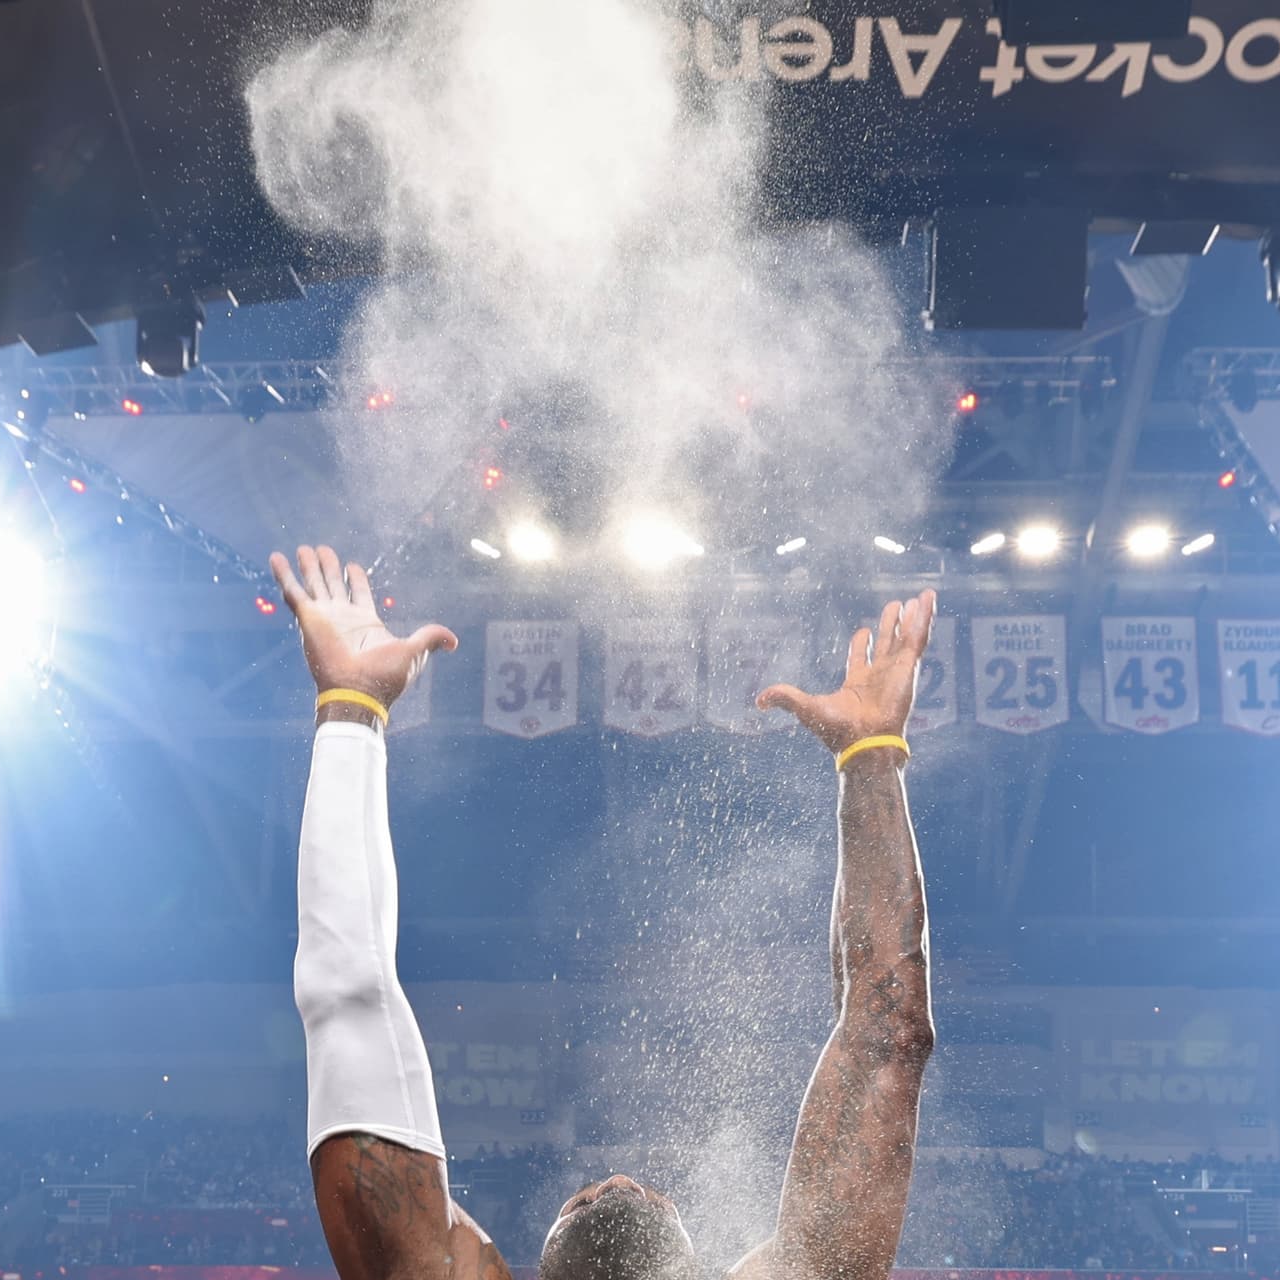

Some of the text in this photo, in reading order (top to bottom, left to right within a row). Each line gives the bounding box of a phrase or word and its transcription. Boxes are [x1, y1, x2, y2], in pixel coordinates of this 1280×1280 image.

[993, 624, 1043, 636] MARK
[994, 639, 1042, 651] PRICE
[1106, 640, 1192, 651] DAUGHERTY
[1126, 624, 1172, 636] BRAD
[496, 661, 566, 712] 34
[615, 660, 682, 711] 42
[917, 657, 947, 710] 2
[985, 657, 1058, 710] 25
[1114, 657, 1187, 710] 43
[1080, 1040, 1174, 1066] LET
[1079, 1072, 1257, 1105] KNOW
